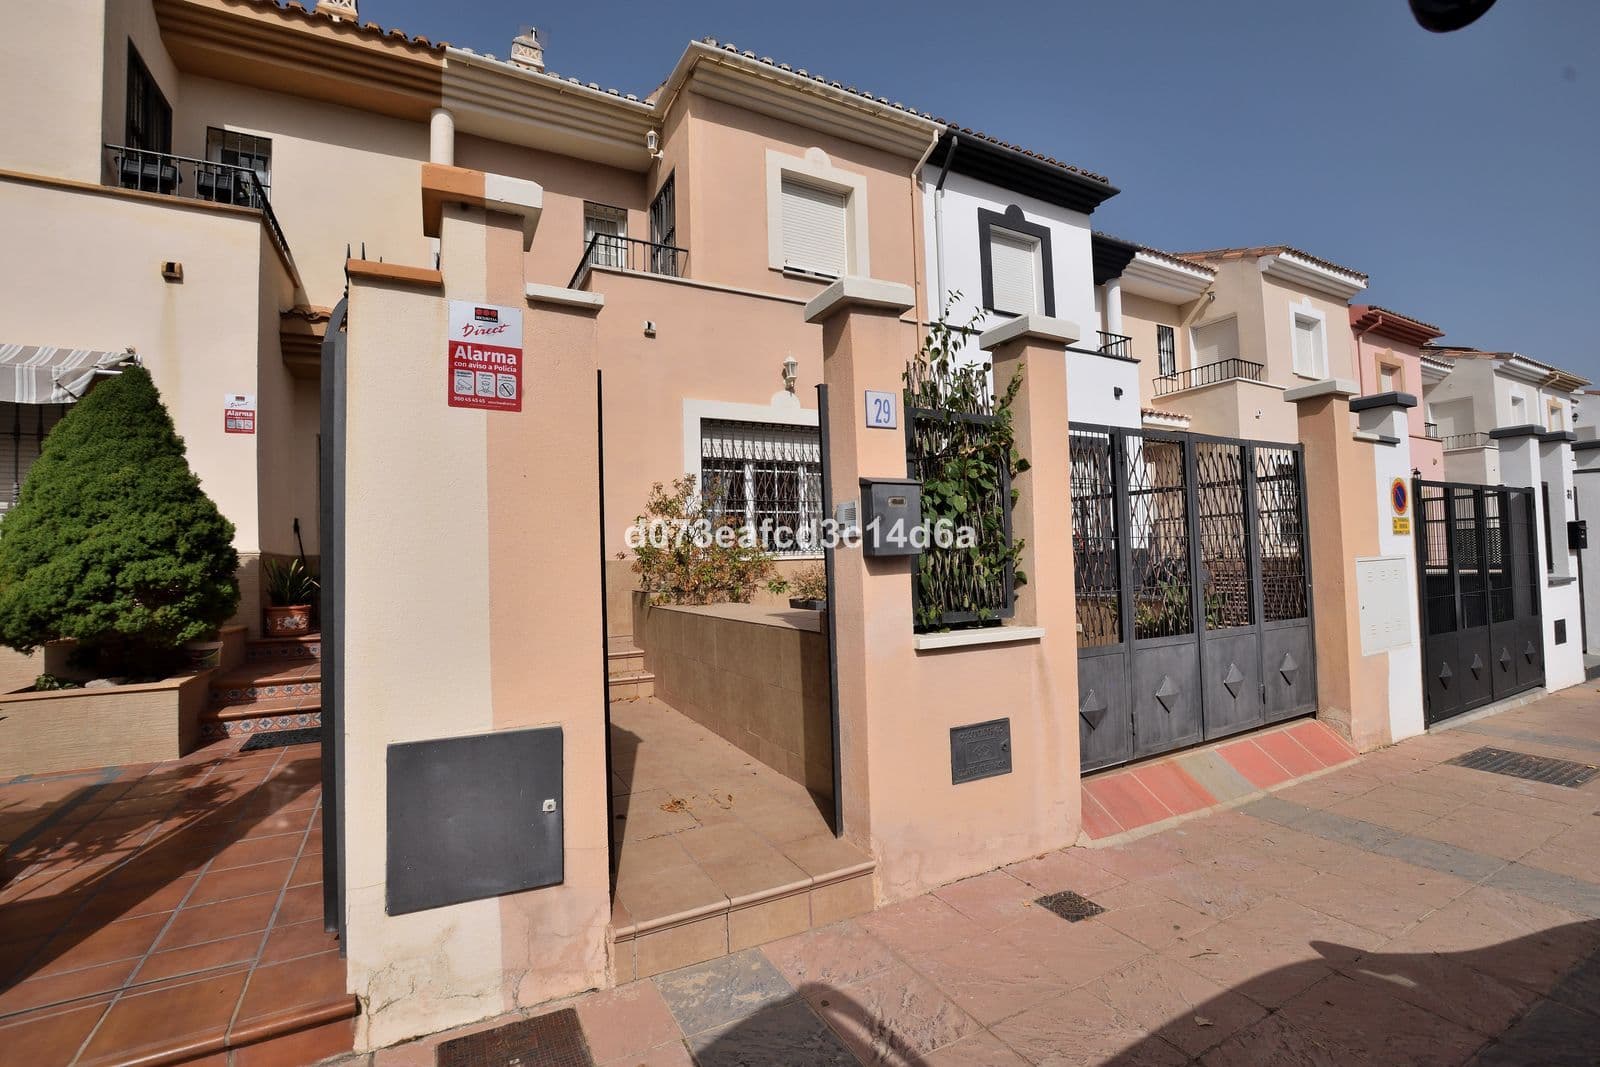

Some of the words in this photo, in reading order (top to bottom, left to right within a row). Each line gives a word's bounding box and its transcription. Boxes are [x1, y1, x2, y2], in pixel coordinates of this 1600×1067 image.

[461, 323, 511, 338] Direct
[454, 345, 517, 365] Alarma
[468, 362, 487, 370] aviso
[874, 398, 891, 424] 29
